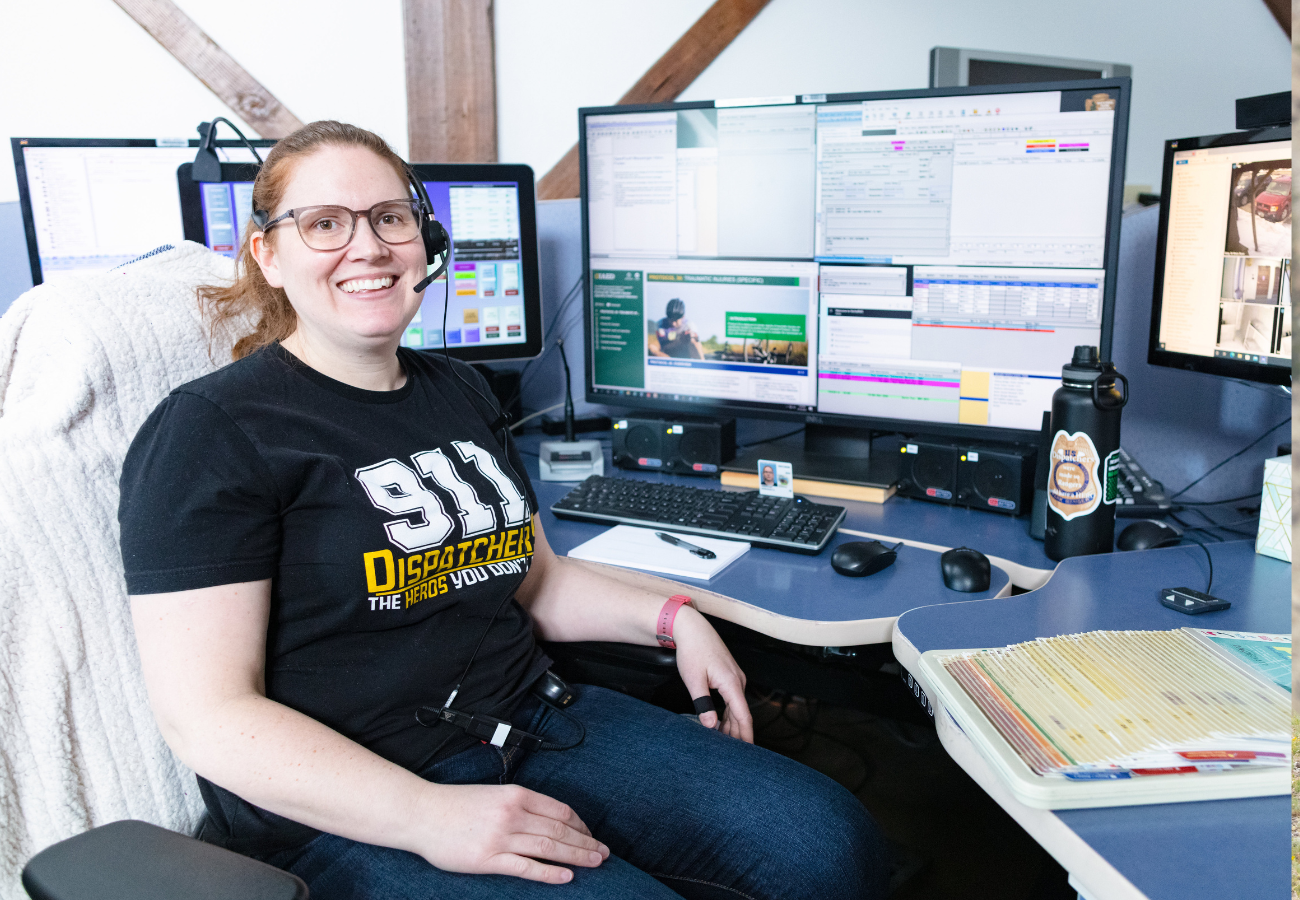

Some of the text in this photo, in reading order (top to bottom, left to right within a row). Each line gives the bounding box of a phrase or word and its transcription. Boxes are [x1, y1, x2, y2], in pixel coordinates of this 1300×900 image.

[1053, 451, 1094, 462] Dispatchers
[354, 440, 530, 553] 911
[1058, 479, 1082, 488] Rangers
[368, 595, 401, 610] THE
[405, 576, 448, 609] HEROS
[449, 566, 489, 589] YOU
